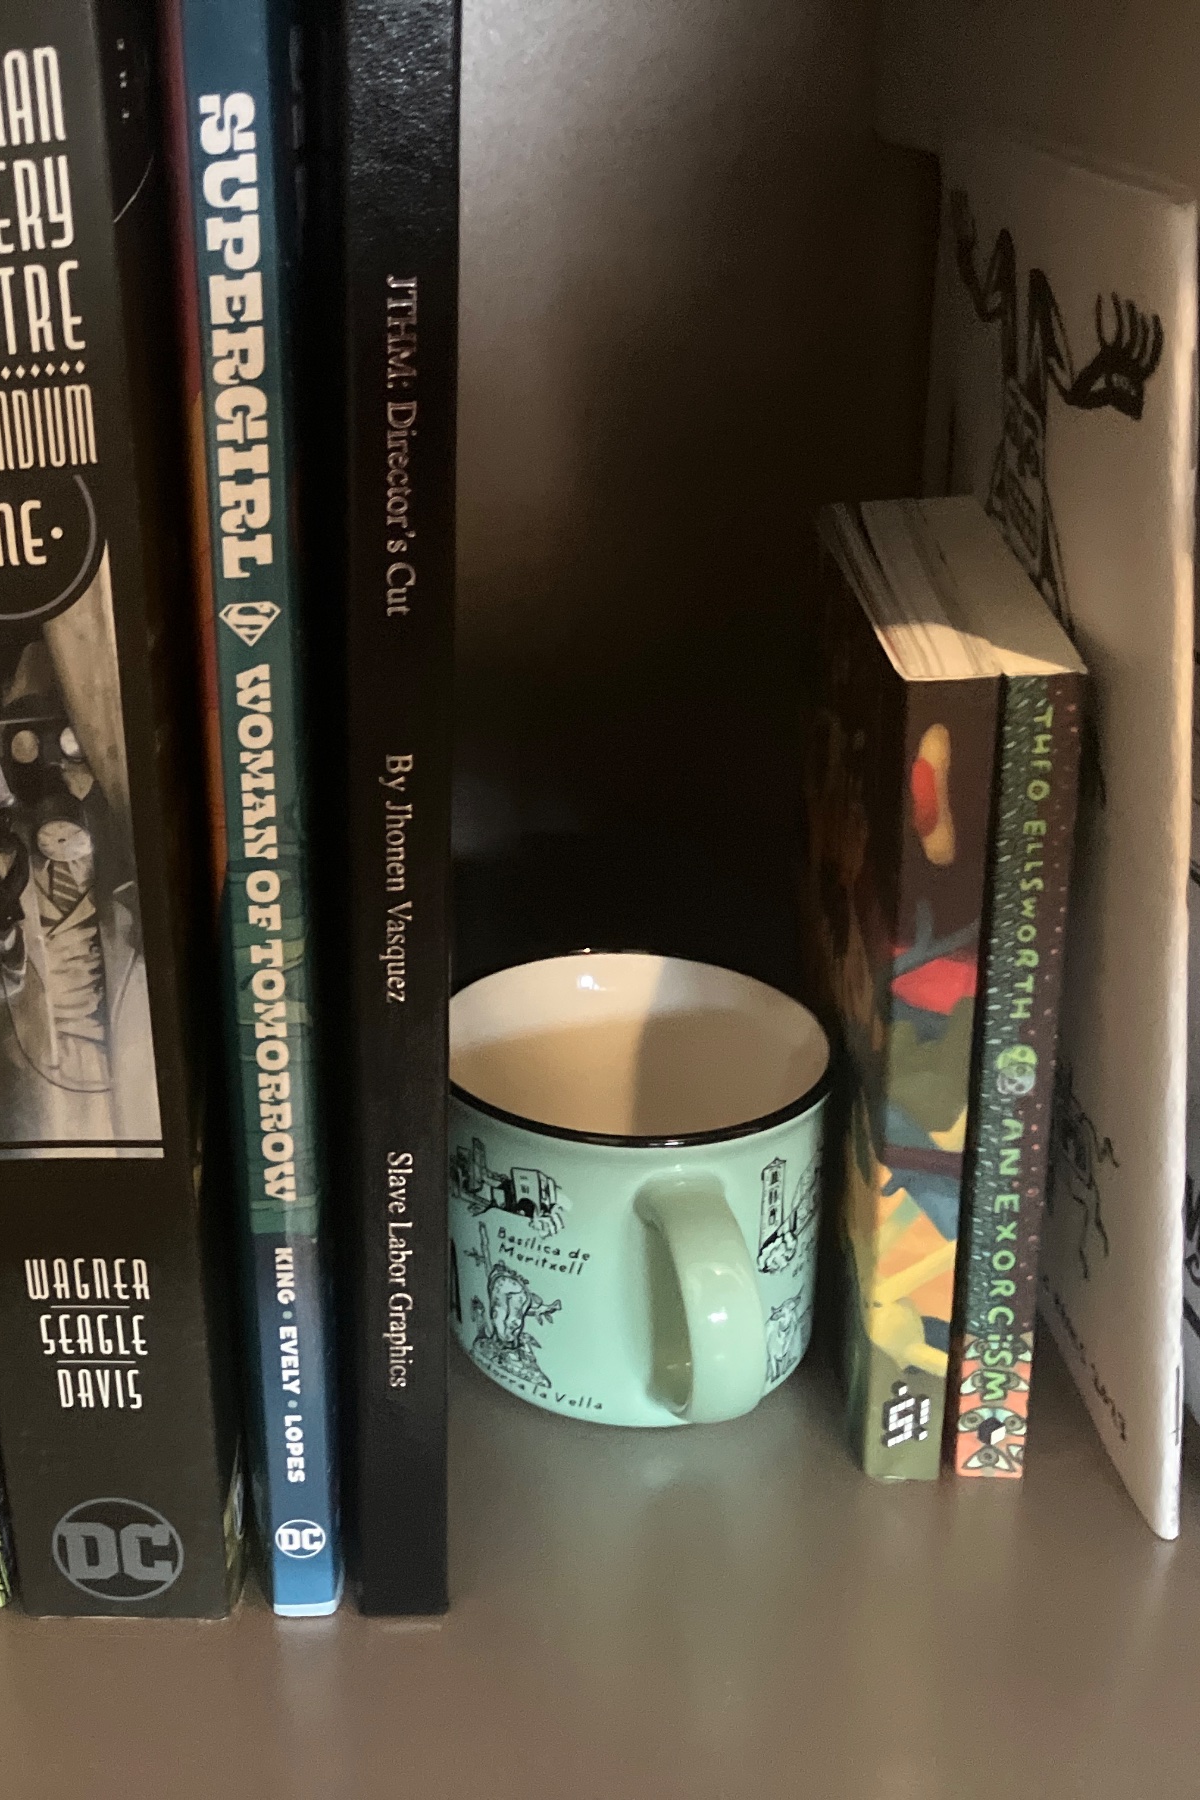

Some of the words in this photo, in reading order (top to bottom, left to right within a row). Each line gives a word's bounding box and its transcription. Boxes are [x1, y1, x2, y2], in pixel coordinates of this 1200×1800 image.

[199, 91, 274, 579] SUPERGIRL
[386, 273, 419, 389] JTHM:
[386, 399, 419, 554] Director's
[386, 562, 417, 617] Cut
[235, 662, 280, 860] WOMAN
[378, 753, 414, 792] By
[1025, 704, 1054, 802] THEO
[384, 800, 413, 893] Jhonen
[246, 869, 282, 932] OF
[1008, 818, 1048, 1020] ELLSWORTH
[378, 901, 413, 1004] Vasquez
[250, 938, 297, 1202] TOMORROW
[998, 1118, 1024, 1178] AN
[386, 1151, 414, 1214] Slave
[24, 1257, 152, 1301] WAGNER
[274, 1246, 296, 1305] KING
[387, 1221, 414, 1288] Labor
[498, 1242, 584, 1276] Meritxell
[567, 1247, 591, 1262] de
[39, 1313, 149, 1356] SEAGLE
[278, 1325, 302, 1396] EVELY
[382, 1291, 414, 1389] Graphics
[56, 1368, 144, 1410] DAVIS
[533, 1384, 548, 1400] la
[554, 1391, 604, 1410] Vella
[284, 1414, 306, 1483] LOPES
[55, 1516, 179, 1588] DC
[277, 1524, 324, 1555] DC
